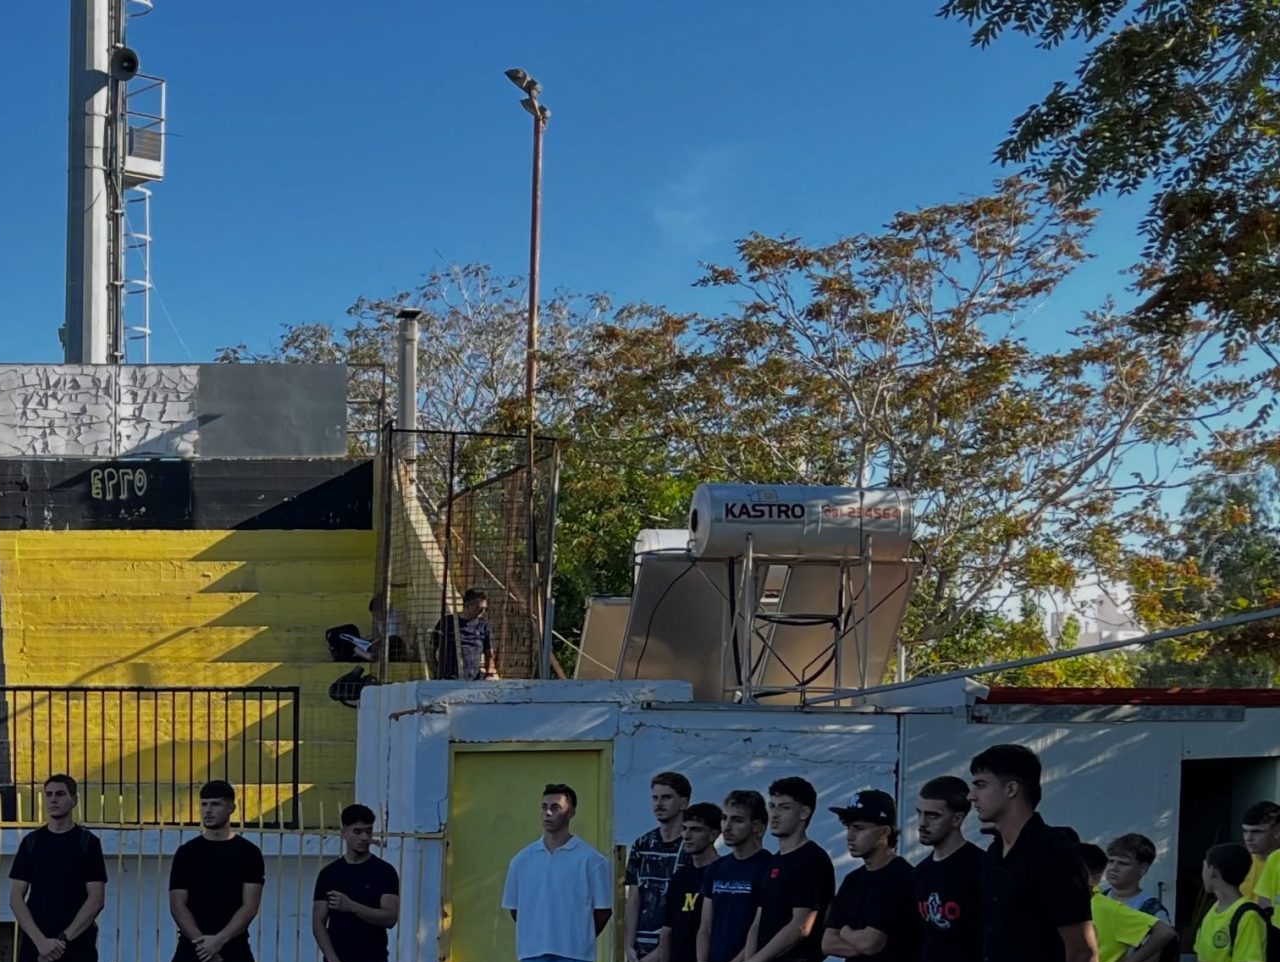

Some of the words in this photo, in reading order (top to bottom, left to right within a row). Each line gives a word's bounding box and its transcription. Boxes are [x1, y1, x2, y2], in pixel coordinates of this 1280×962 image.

[91, 468, 147, 500] ΕΡΓΟ
[725, 503, 805, 519] KASTRO
[681, 892, 700, 911] N
